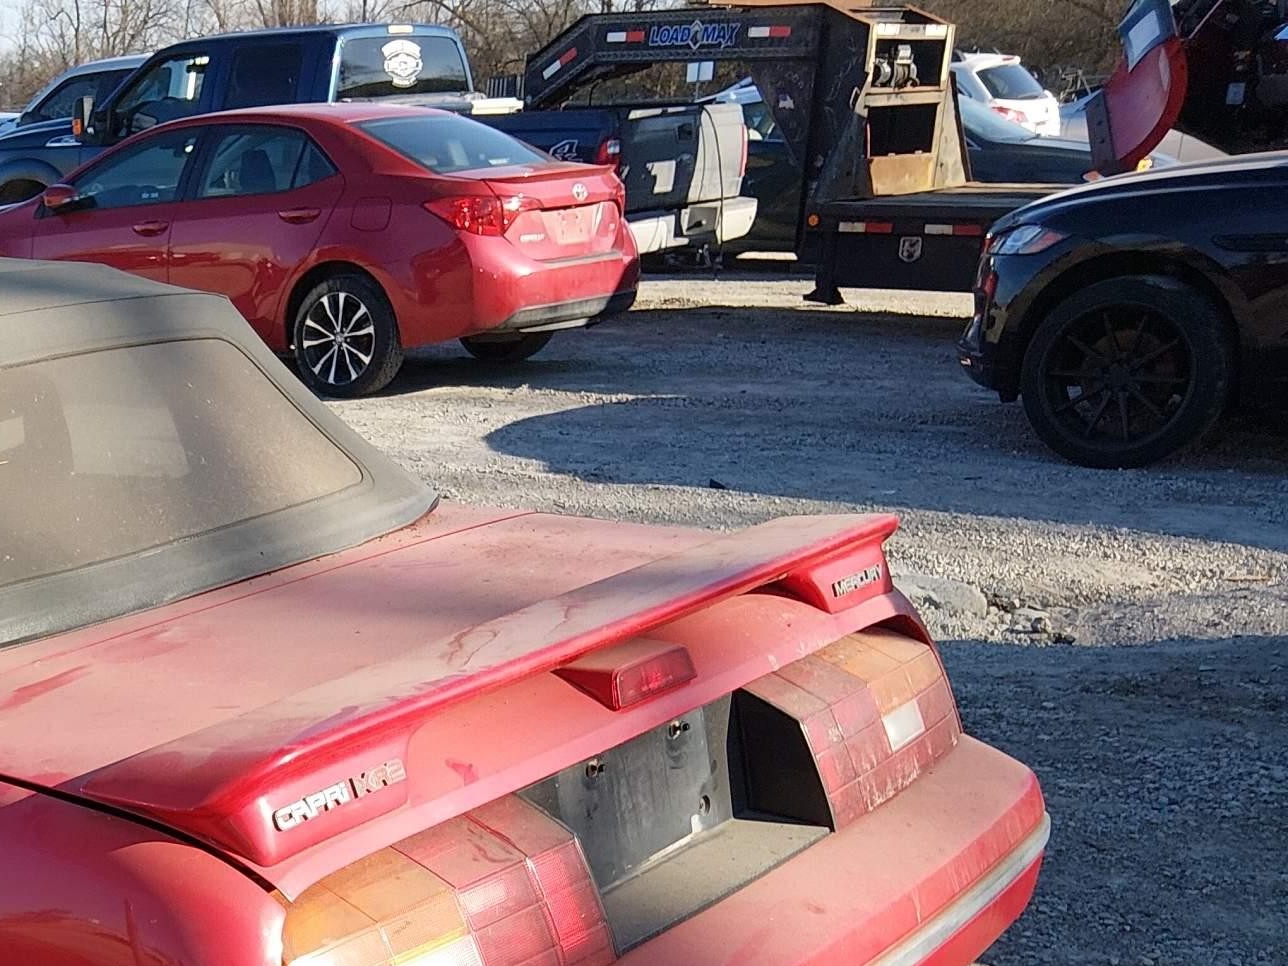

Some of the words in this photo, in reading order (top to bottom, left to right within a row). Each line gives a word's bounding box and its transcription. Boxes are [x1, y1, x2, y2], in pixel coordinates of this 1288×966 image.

[649, 26, 691, 46] LOAD
[702, 23, 741, 48] MAX
[835, 565, 881, 597] MERCURY
[273, 781, 352, 832] CAPRI
